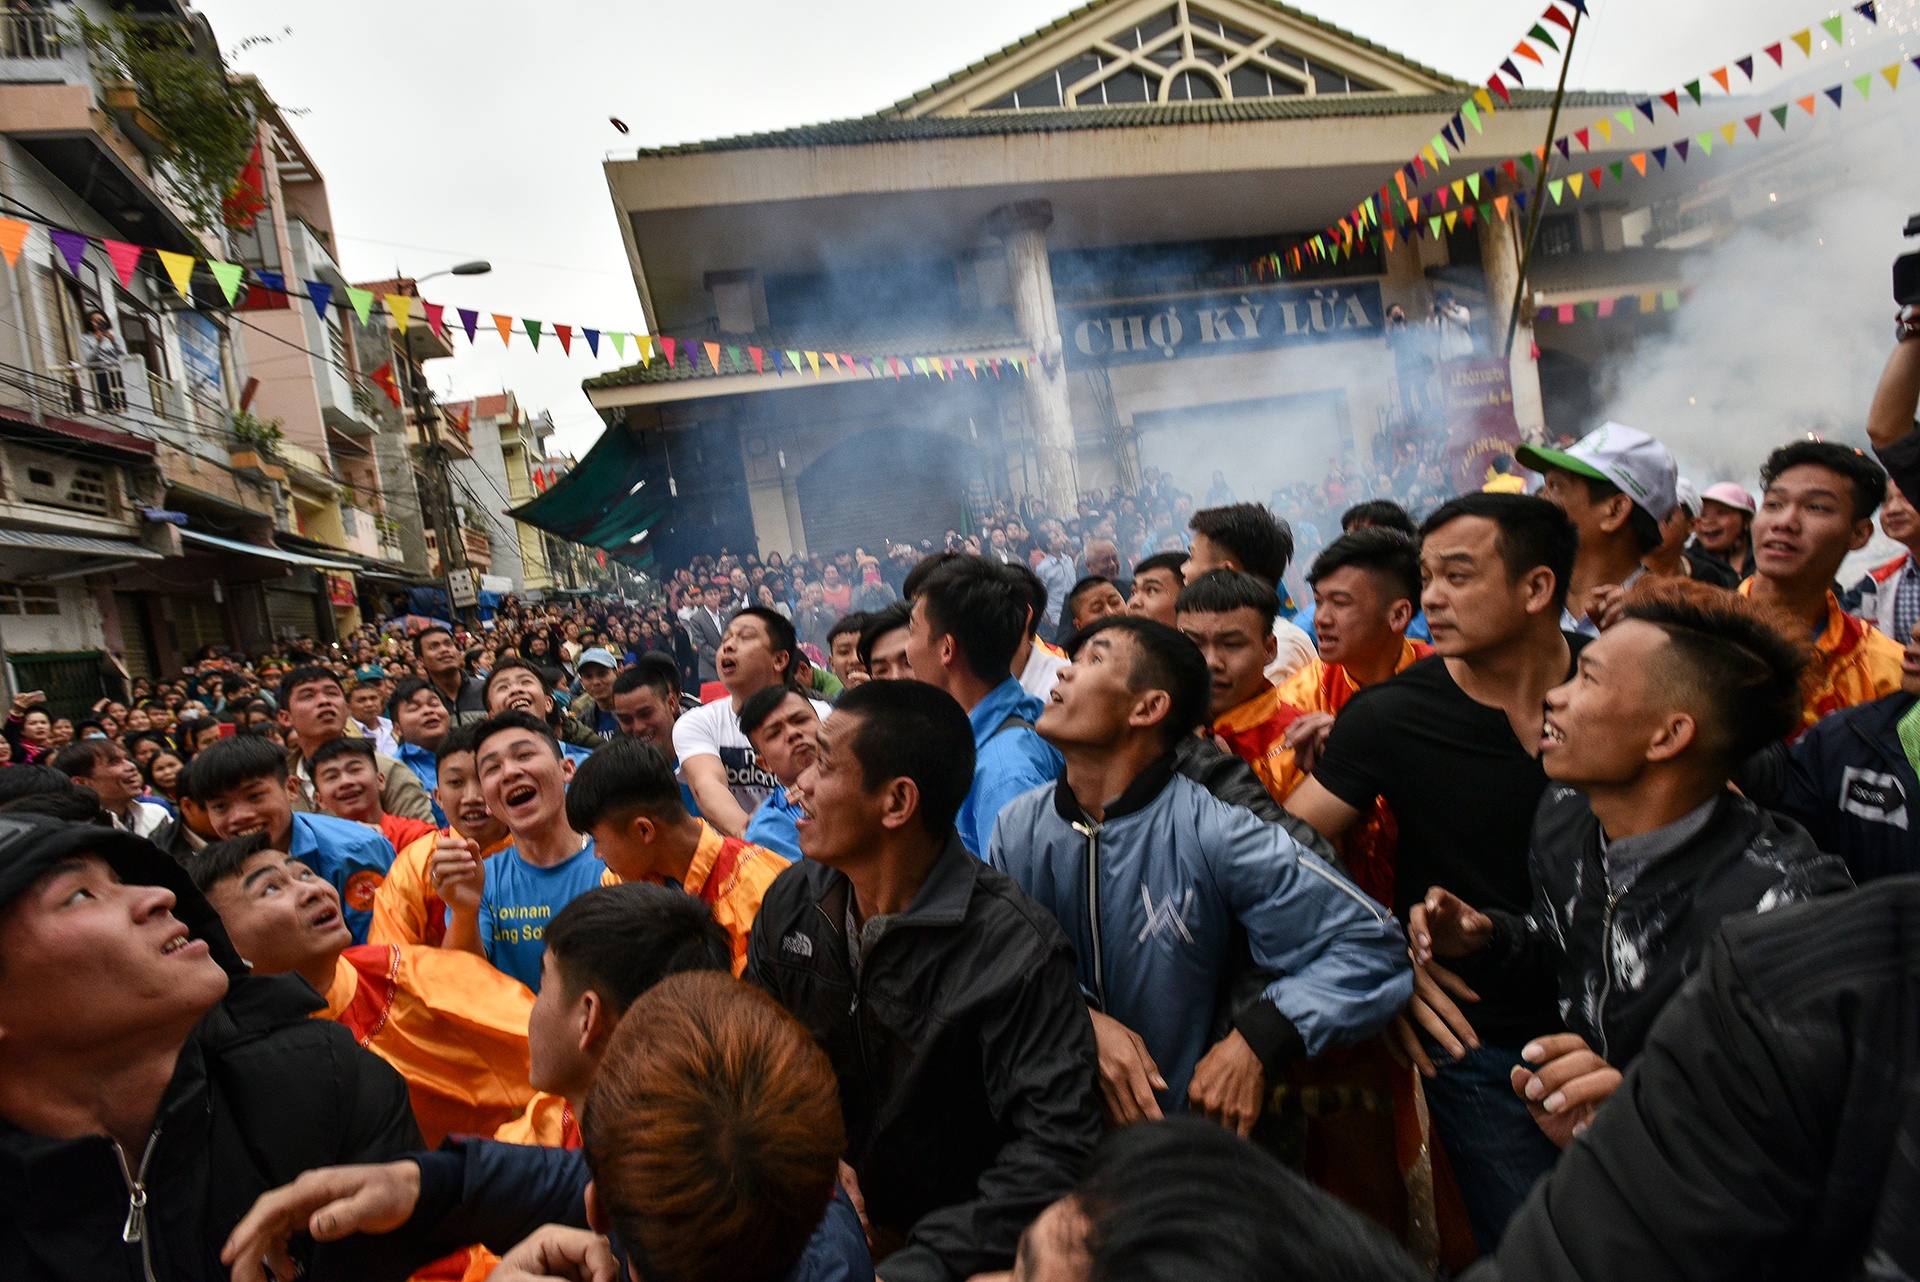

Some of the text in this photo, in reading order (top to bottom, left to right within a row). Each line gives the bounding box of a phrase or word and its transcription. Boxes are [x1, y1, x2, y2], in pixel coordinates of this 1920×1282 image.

[1074, 288, 1374, 358] CHỢ KỲ LỪA
